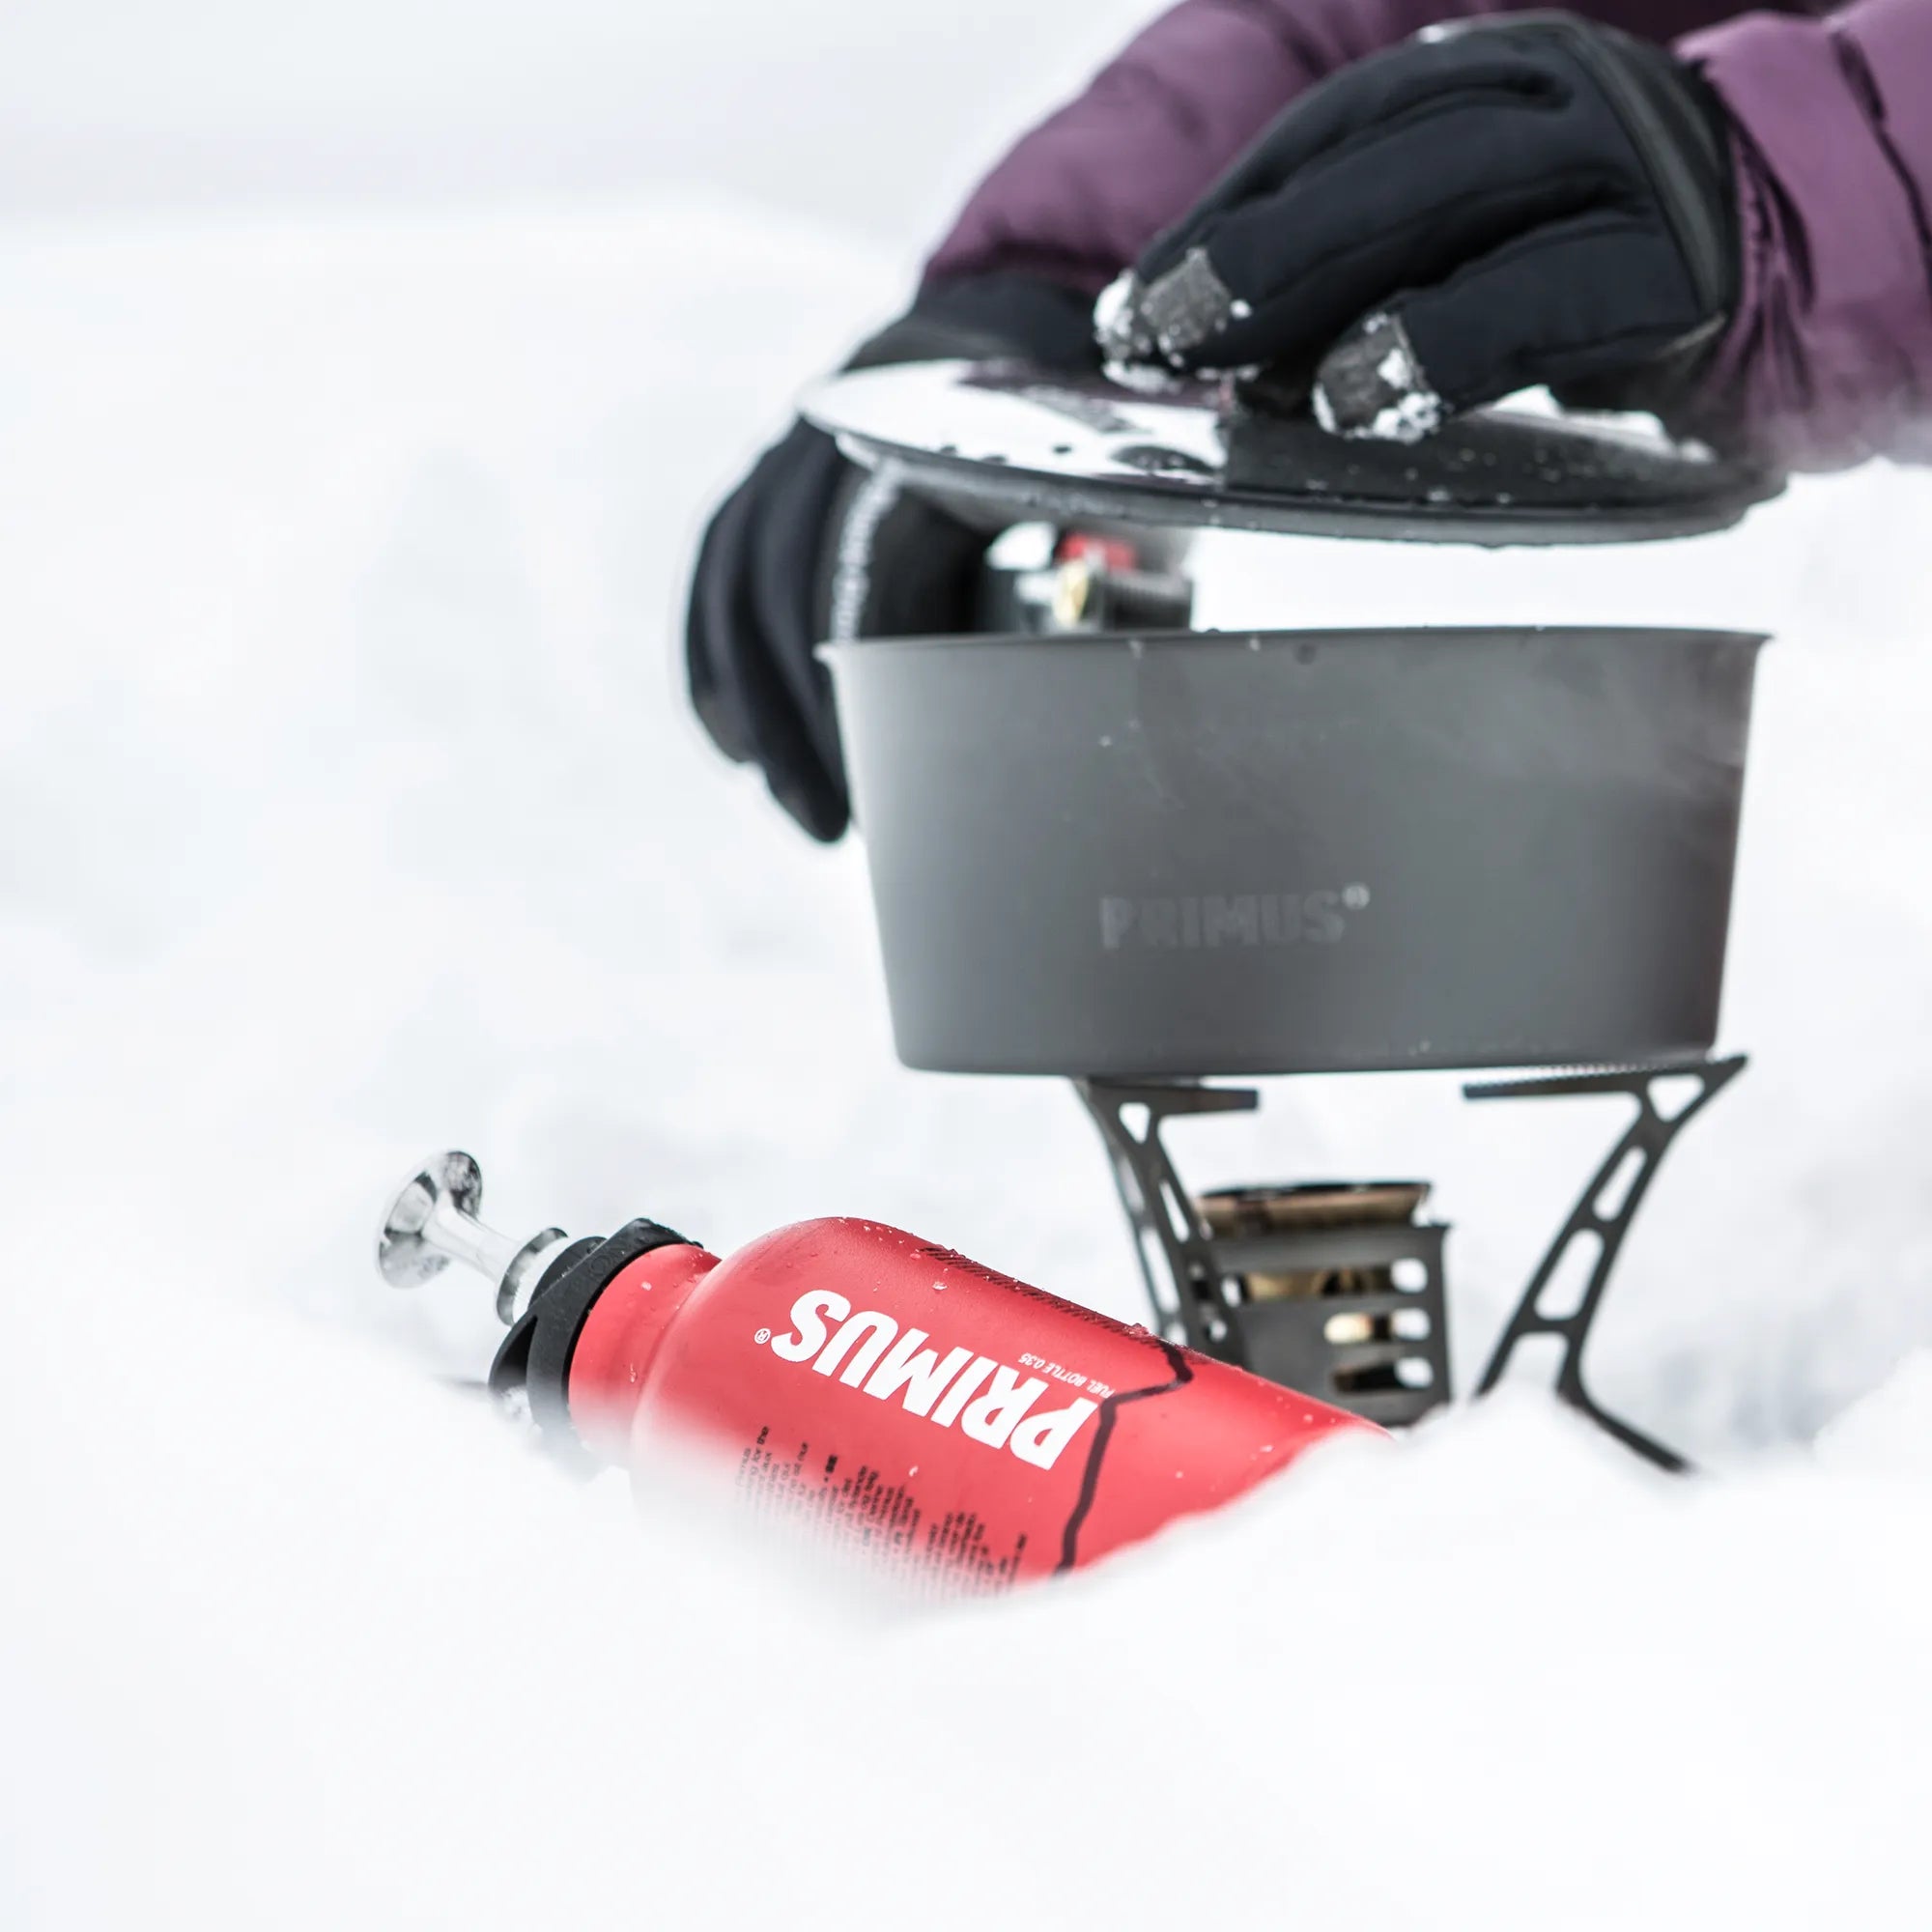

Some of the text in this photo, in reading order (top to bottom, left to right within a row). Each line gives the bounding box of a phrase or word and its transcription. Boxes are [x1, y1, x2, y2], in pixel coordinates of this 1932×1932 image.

[1017, 1351, 1116, 1399] FUEL BOTTLE 0.35
